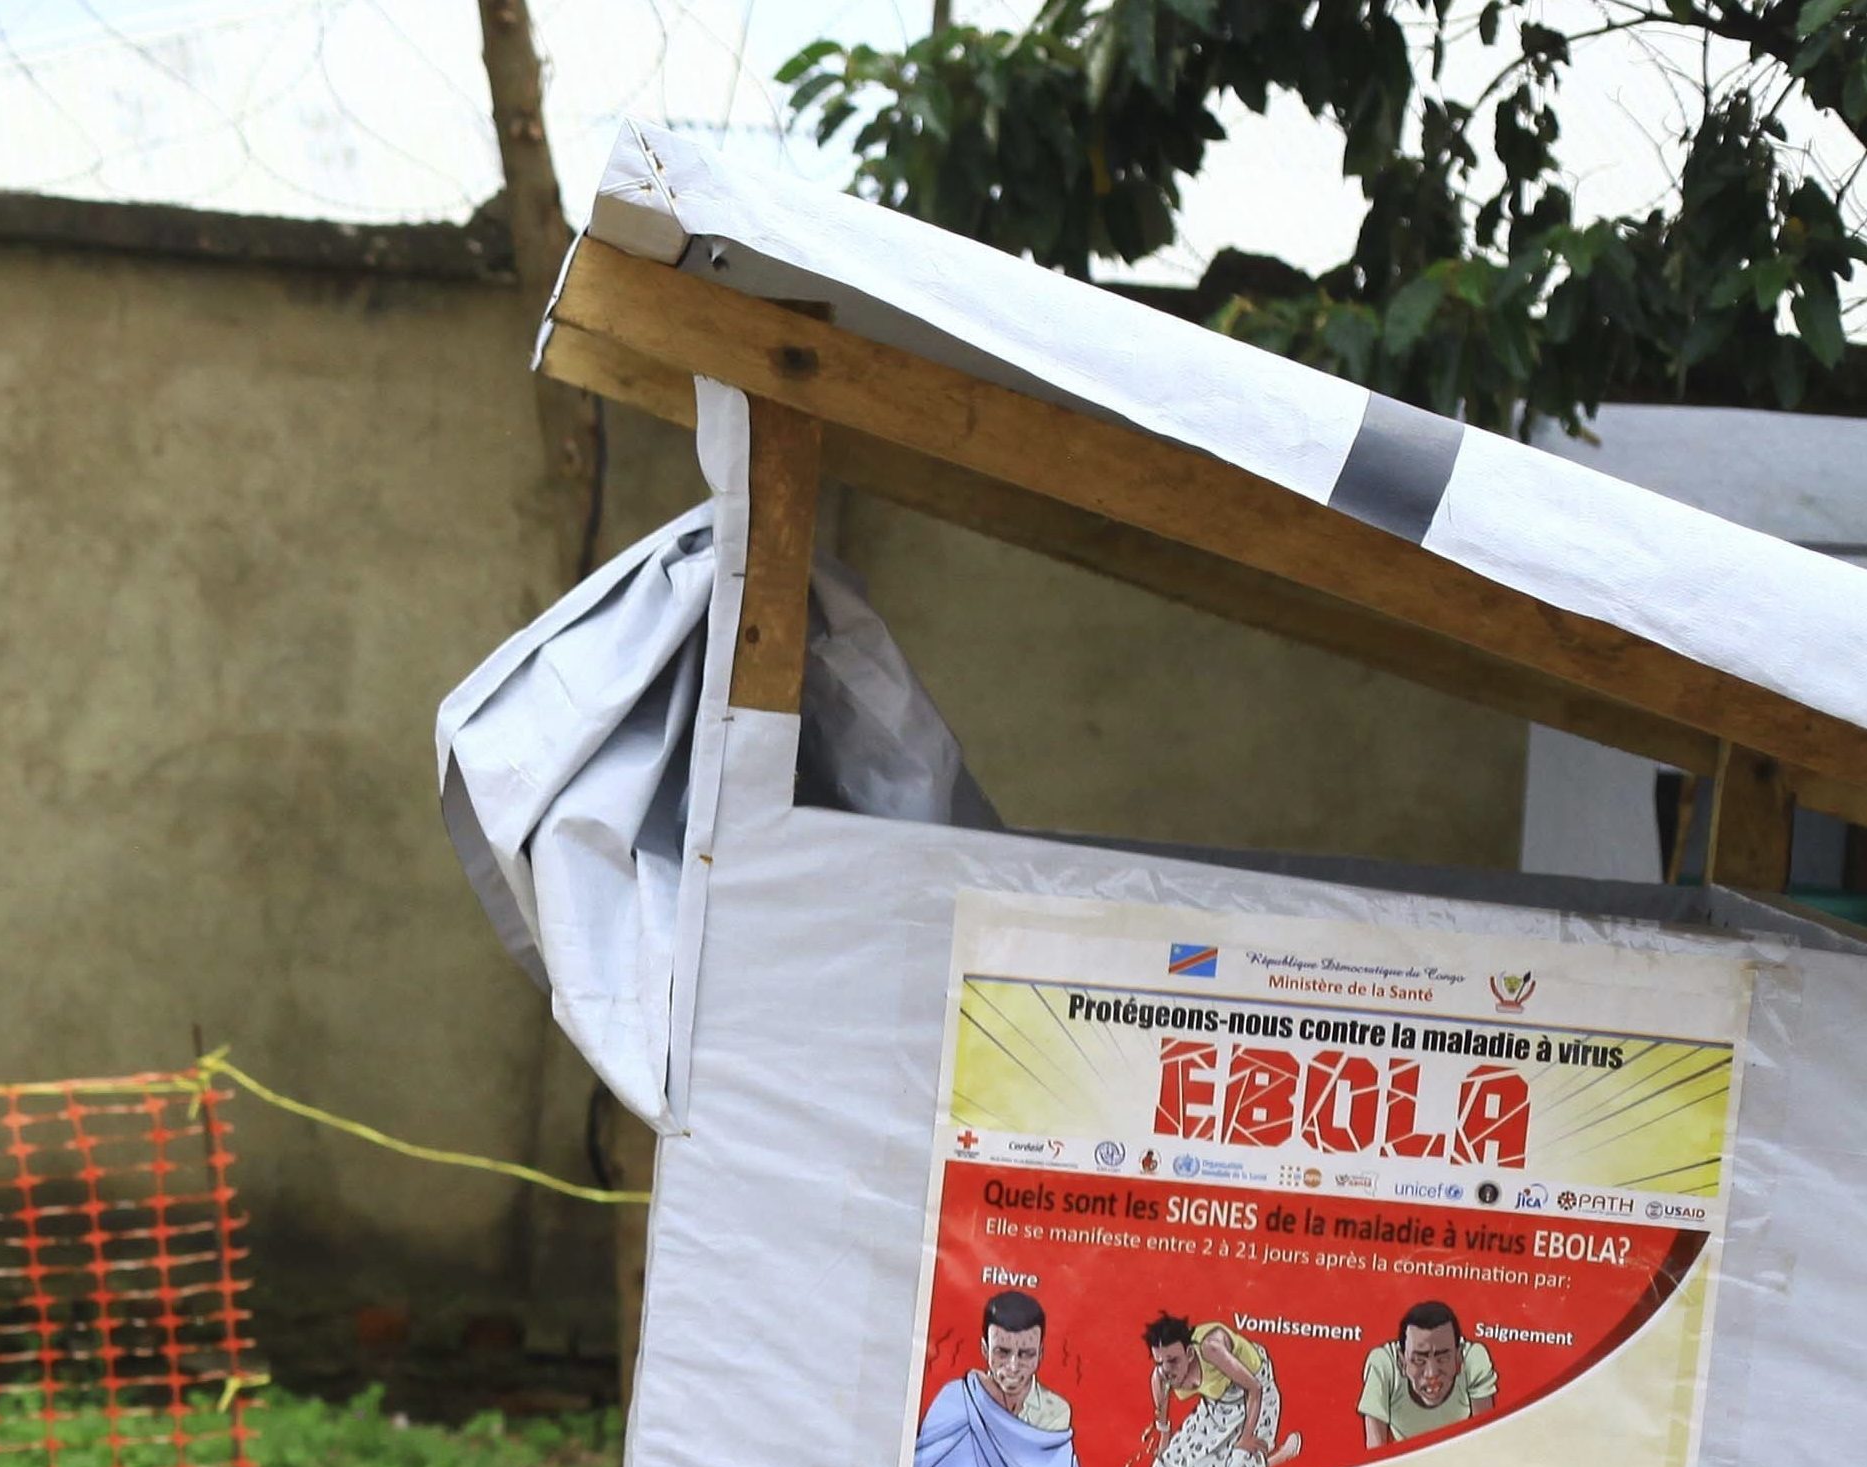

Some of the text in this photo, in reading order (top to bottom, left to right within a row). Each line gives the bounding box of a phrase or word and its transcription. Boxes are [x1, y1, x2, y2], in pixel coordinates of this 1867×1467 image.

[1268, 975, 1433, 1002] Ministère de la Santé
[1425, 967, 1465, 985] Congo
[1068, 993, 1624, 1070] Protégeons-nous contre la maladie à virus
[1153, 1037, 1531, 1169] EBOLA
[1395, 1183, 1443, 1199] unicef
[1579, 1193, 1634, 1213] PATH
[984, 1180, 1631, 1265] Quels sont les SIGNES de la maladie à virus EBOLA?
[1665, 1206, 1705, 1218] USAID
[986, 1218, 1570, 1290] Elle se manifeste entre 2 à 21 jours après la contamination par:
[981, 1266, 1039, 1289] Fièvre
[1234, 1313, 1363, 1341] Vomissement
[1475, 1322, 1573, 1346] Saignement
